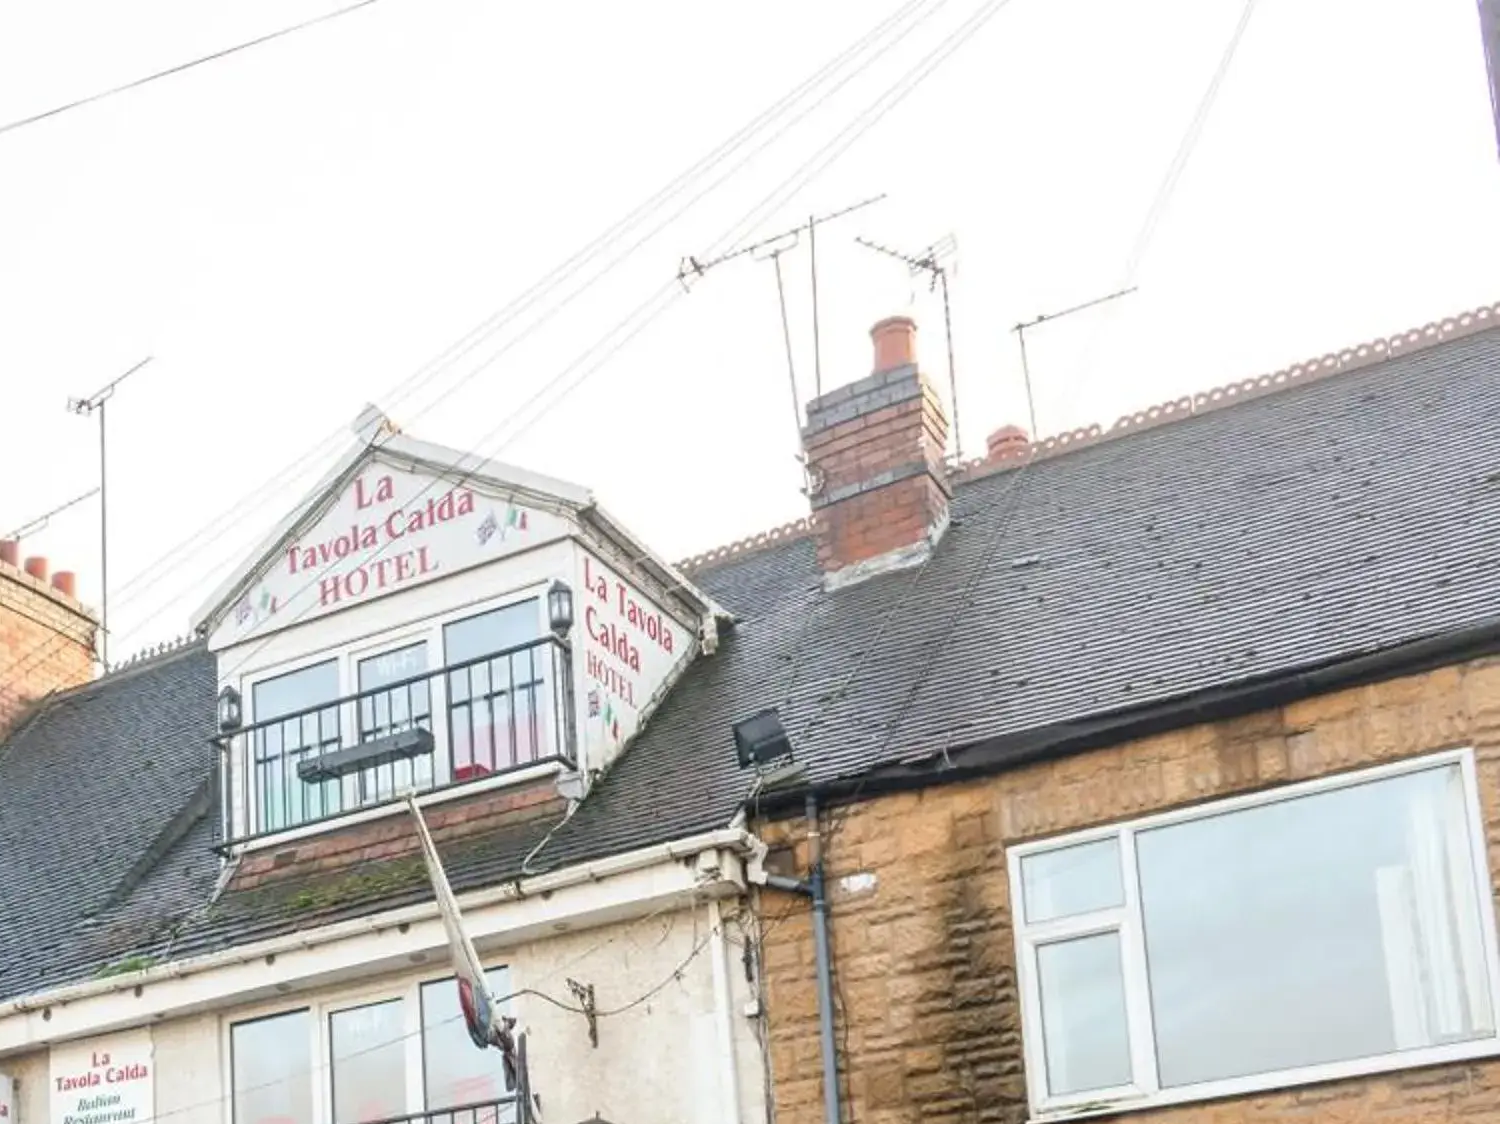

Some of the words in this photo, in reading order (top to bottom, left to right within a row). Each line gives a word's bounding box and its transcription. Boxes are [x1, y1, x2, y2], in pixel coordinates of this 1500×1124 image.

[355, 475, 395, 510] La
[287, 525, 378, 575] Tavola
[386, 489, 476, 540] Calda
[319, 546, 439, 606] HOTEL
[584, 557, 608, 603] La
[616, 583, 673, 655] Tavola
[585, 605, 640, 674] Calda
[586, 648, 637, 708] HOTEL
[55, 1073, 101, 1093] Tavola
[106, 1064, 148, 1084] Calda
[92, 1052, 111, 1068] La
[77, 1094, 121, 1112] Italian
